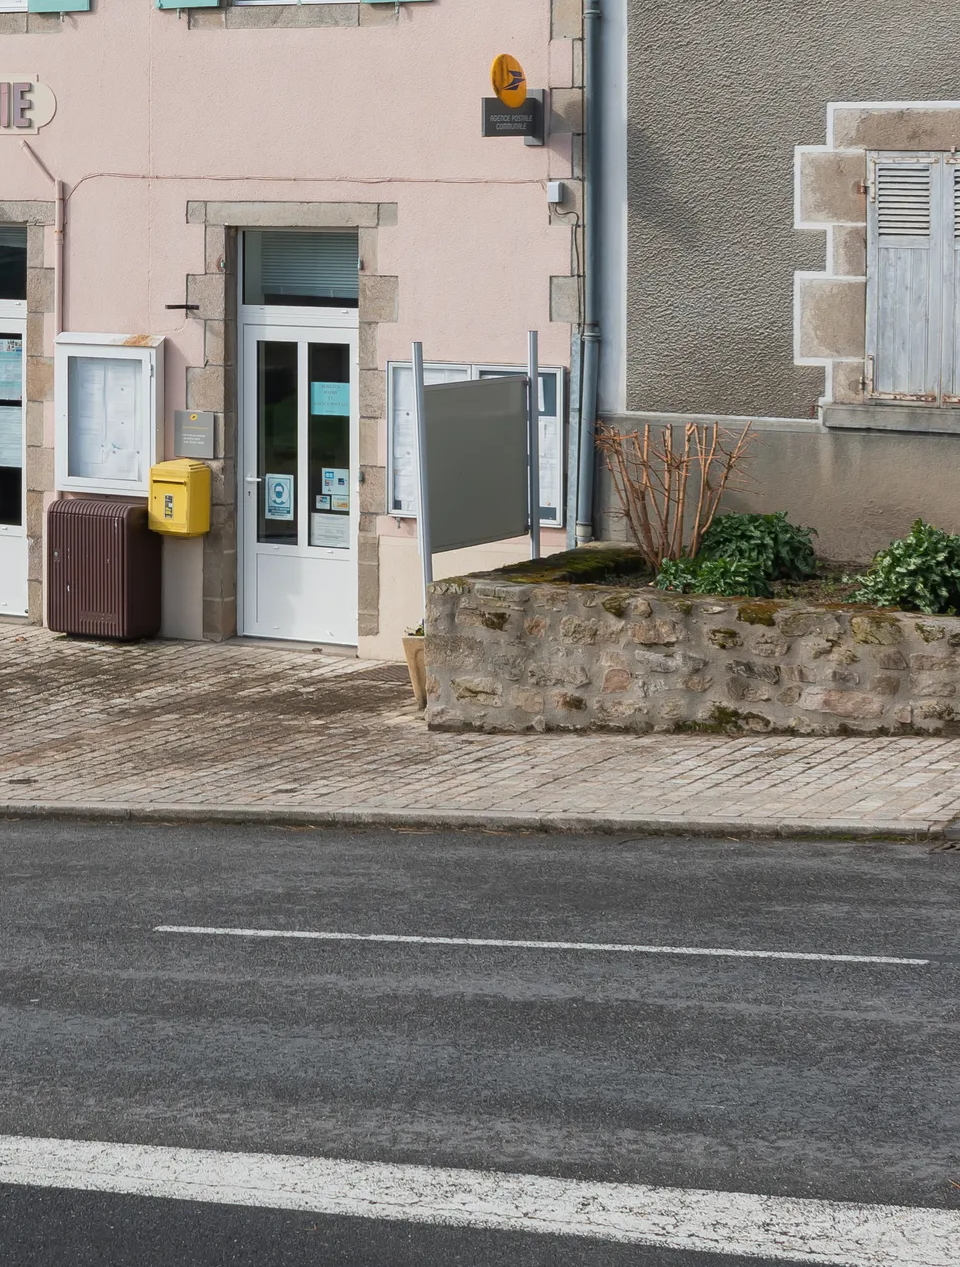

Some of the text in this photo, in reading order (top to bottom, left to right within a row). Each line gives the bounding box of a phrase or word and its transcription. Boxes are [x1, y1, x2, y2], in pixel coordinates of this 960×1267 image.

[489, 114, 533, 122] AGENCE POSTALE
[495, 122, 527, 130] COMMUNALE
